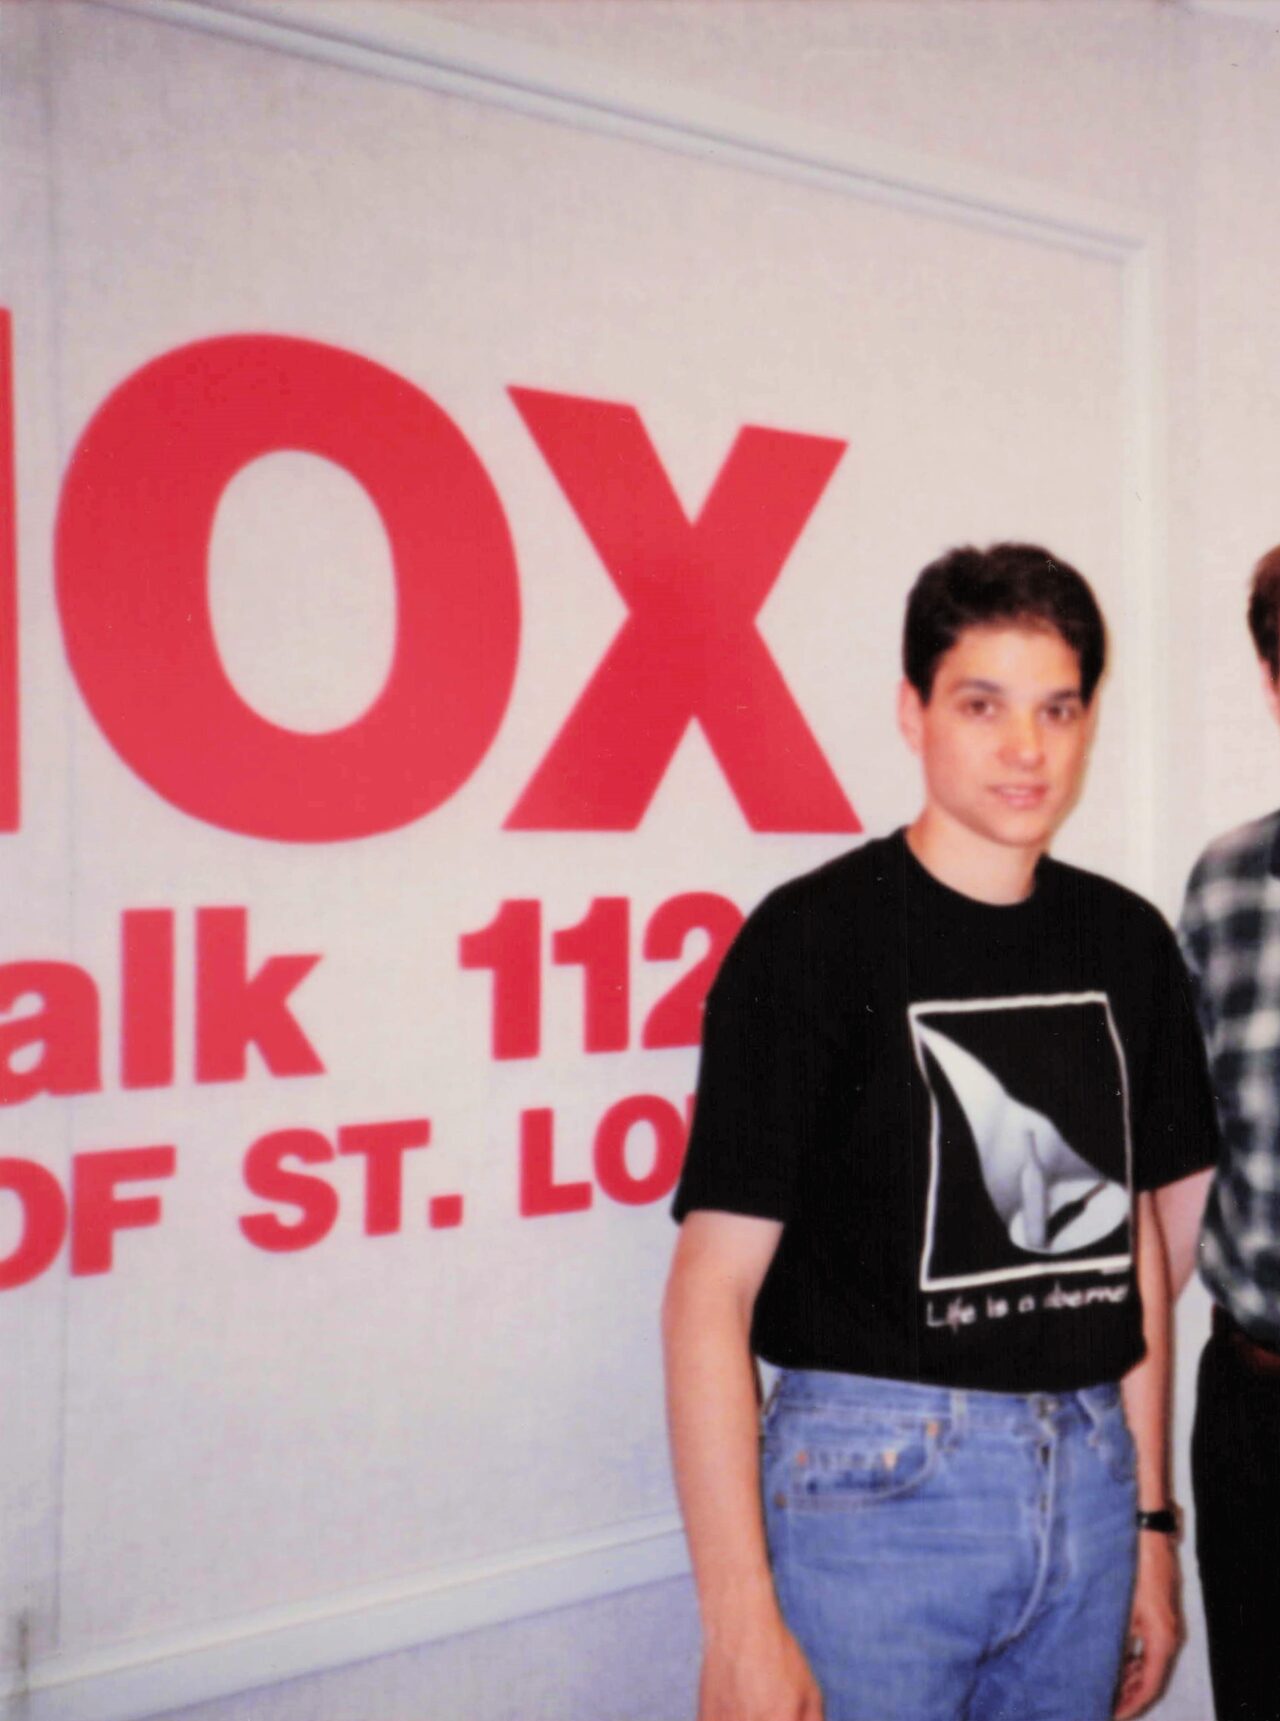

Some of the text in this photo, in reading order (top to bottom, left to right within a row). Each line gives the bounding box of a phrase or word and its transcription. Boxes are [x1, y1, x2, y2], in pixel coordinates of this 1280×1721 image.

[0, 306, 863, 845] OX
[238, 1117, 465, 1254] ST.
[518, 1093, 698, 1220] LO
[926, 1297, 977, 1332] Life
